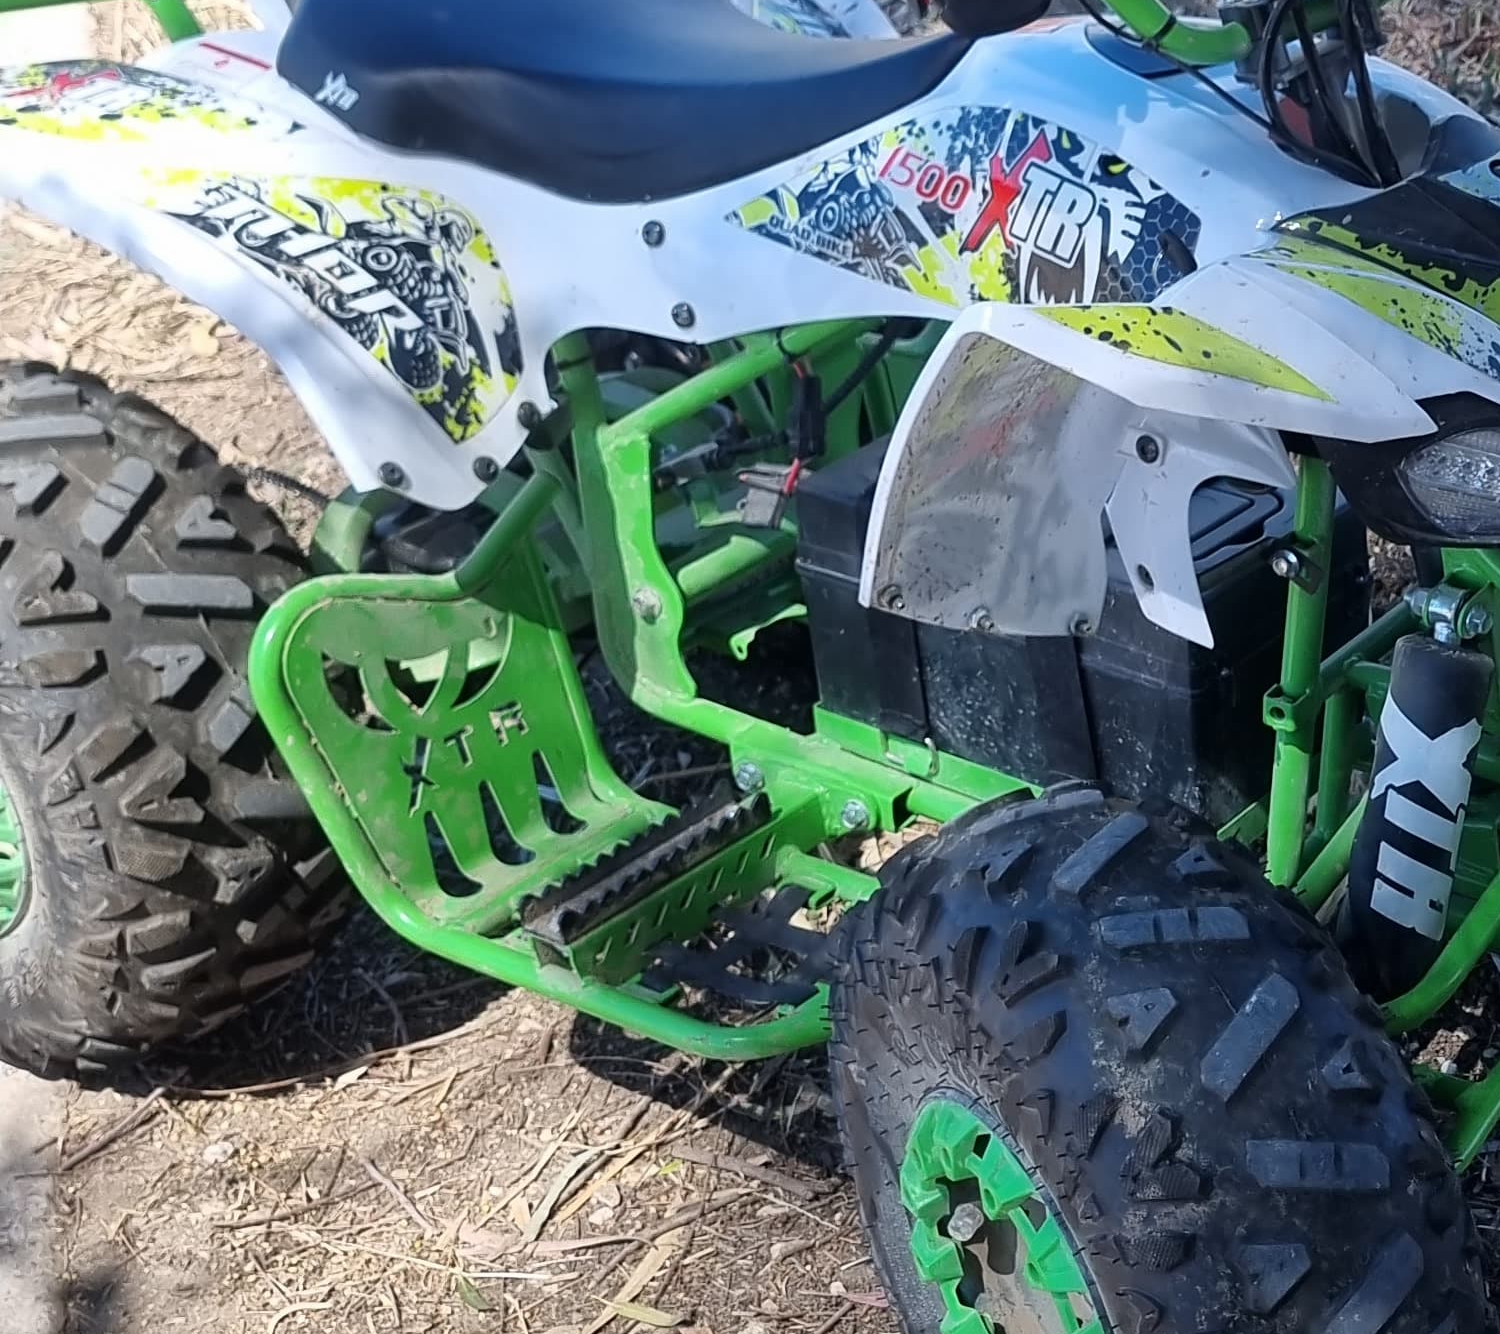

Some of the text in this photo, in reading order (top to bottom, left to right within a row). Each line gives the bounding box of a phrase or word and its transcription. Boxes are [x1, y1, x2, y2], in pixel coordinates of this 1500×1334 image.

[878, 145, 973, 212] 1500
[203, 185, 423, 339] THOR
[768, 214, 853, 257] QUAD BIKE
[402, 701, 530, 817] XTR
